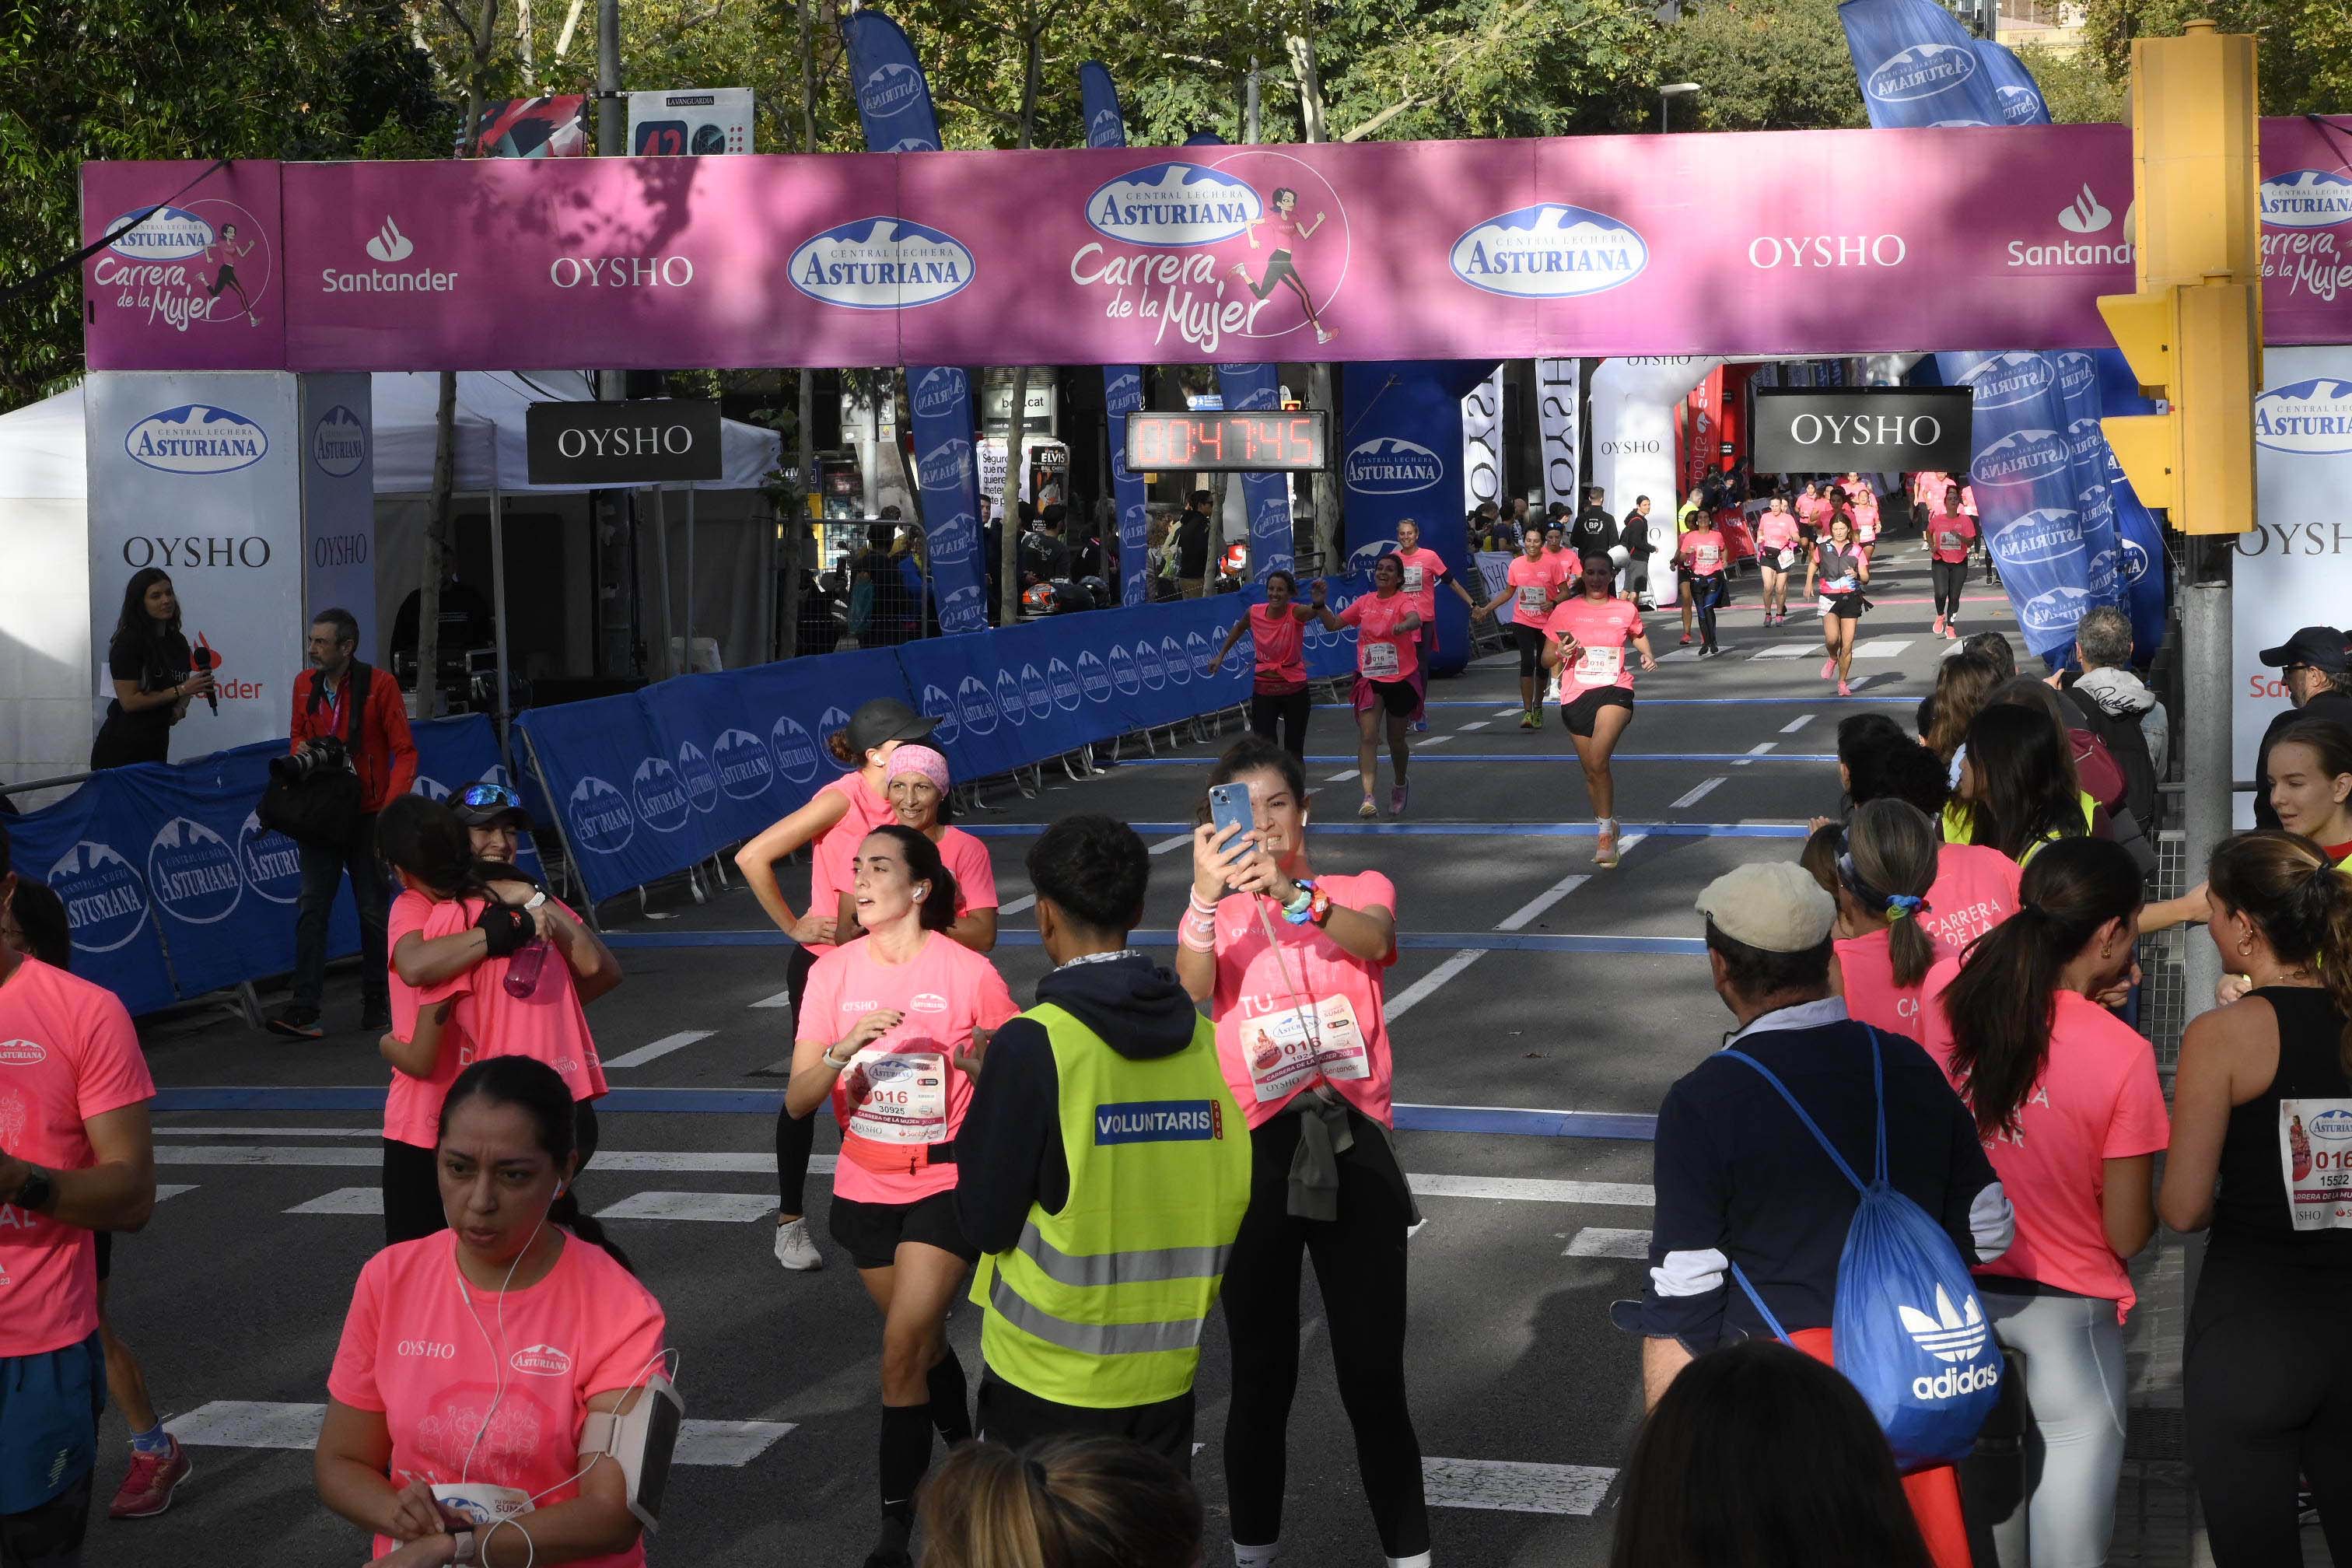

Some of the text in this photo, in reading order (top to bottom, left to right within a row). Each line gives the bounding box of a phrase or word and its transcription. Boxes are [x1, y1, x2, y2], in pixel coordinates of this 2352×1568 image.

[1126, 191, 1181, 200] CENTRAL
[1098, 194, 1248, 226] ASTURIANA
[831, 248, 954, 258] CENTRAL LECHERA
[1748, 234, 1906, 268] OYSHO
[2007, 240, 2137, 266] Santand
[2260, 233, 2334, 254] arrera
[802, 252, 961, 285] ASTURIANA
[1070, 242, 1216, 285] Carrera
[1465, 240, 1632, 274] ASTURIANA
[2279, 257, 2292, 277] la
[95, 257, 186, 286] Carrera
[323, 268, 457, 292] Santander
[551, 257, 693, 288] OYSHO
[117, 283, 220, 331] de la Mujer
[1107, 280, 1270, 353] de la Mujer
[558, 425, 692, 458] OYSHO
[1139, 418, 1313, 463] 00:47:45
[1791, 414, 1941, 446] OYSHO
[136, 430, 257, 457] ASTURIANA
[1601, 440, 1660, 455] OYSHO
[1041, 452, 1065, 463] ELVIS
[1348, 461, 1436, 481] ASTURIANA
[123, 537, 271, 568] OYSHO
[315, 533, 367, 568] OYSHO
[159, 860, 237, 902] ASTURIANA
[1927, 898, 2001, 937] CARRERA
[1239, 992, 1273, 1018] TU
[1284, 1037, 1321, 1055] 016
[1266, 1066, 1296, 1081] CARRERA
[1266, 1065, 1359, 1092] OYSHO Santander
[874, 1090, 908, 1104] 016
[879, 1105, 905, 1115] 30925
[858, 1112, 882, 1121] CARRERA
[1098, 1111, 1211, 1134] VOLUNTARIS
[856, 1122, 940, 1138] OYSHO Santander
[2320, 1174, 2350, 1187] 15522
[397, 1341, 455, 1360] OYSHO
[515, 1356, 567, 1370] ASTURIANA
[1913, 1363, 1997, 1400] adidas
[495, 1504, 525, 1513] SUMA
